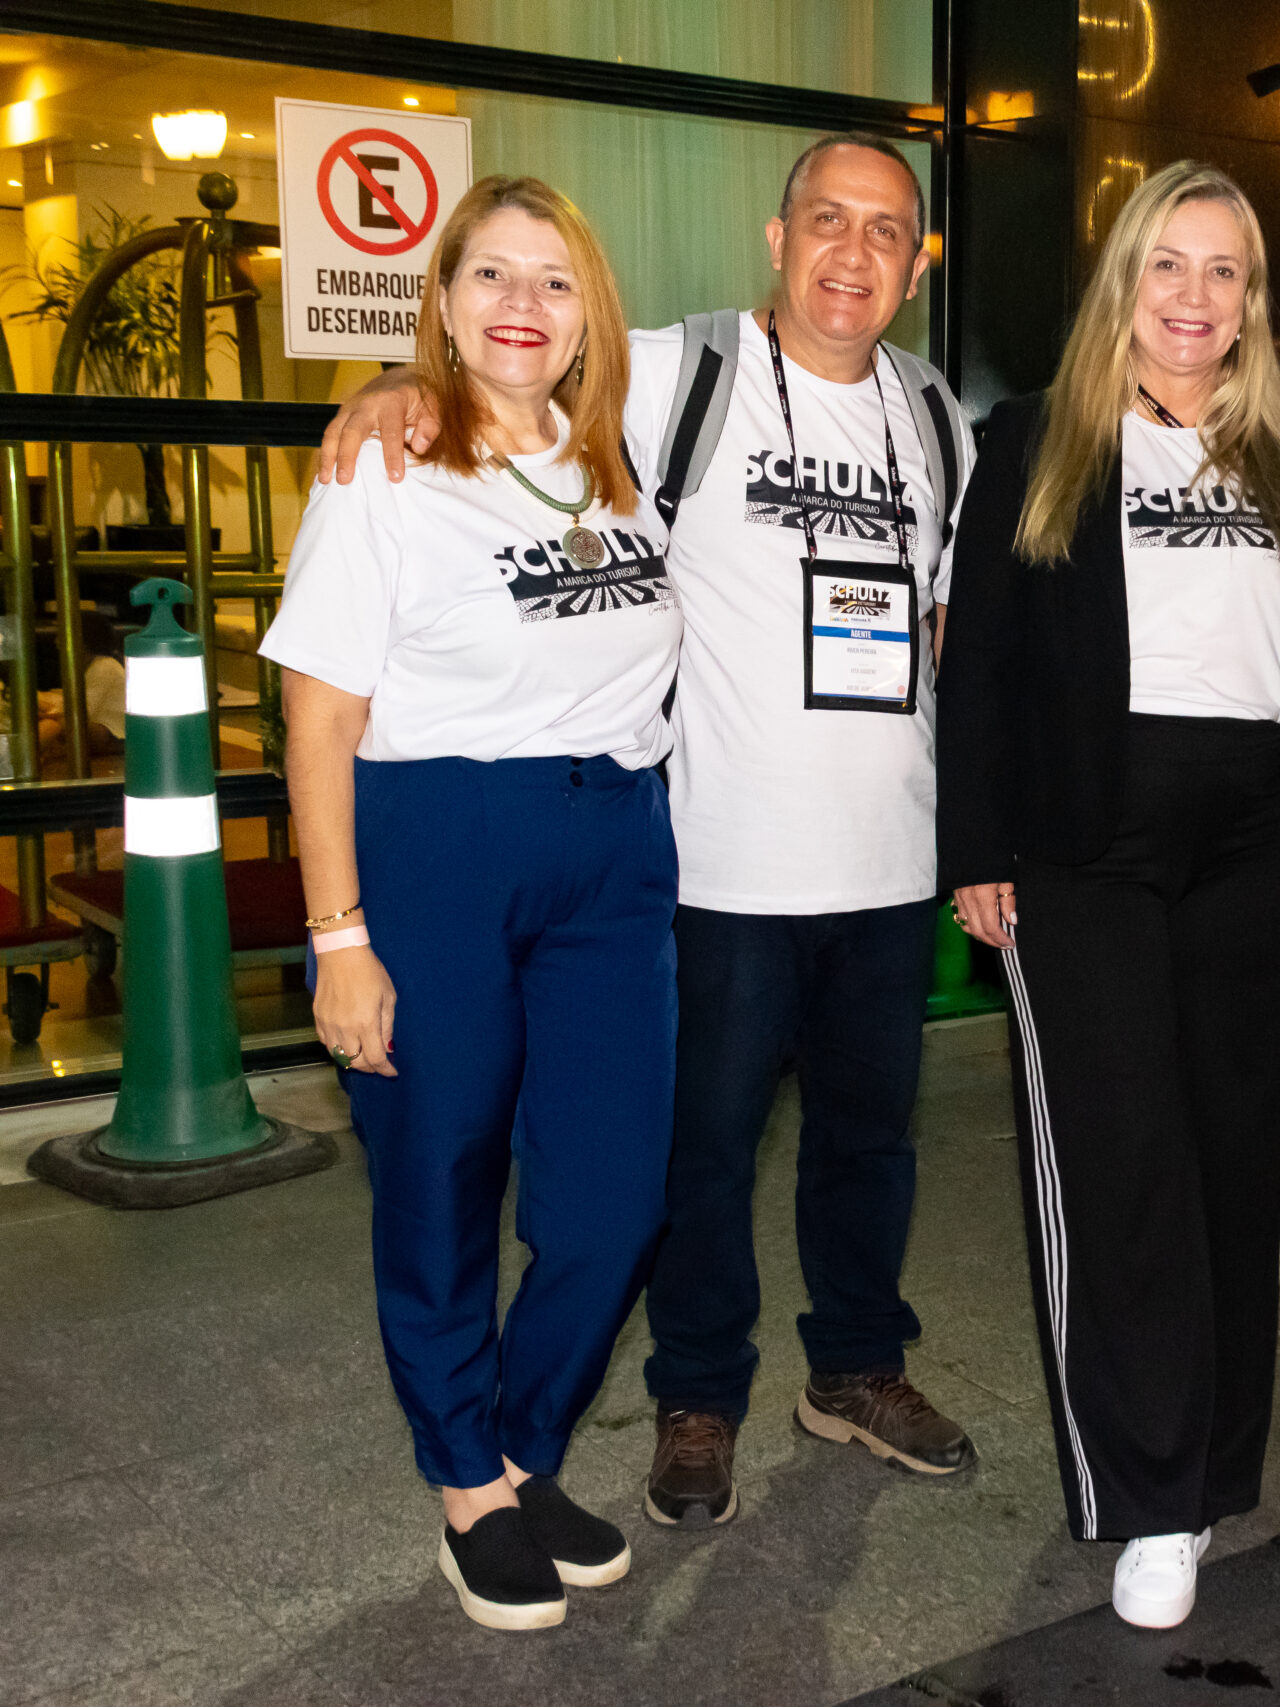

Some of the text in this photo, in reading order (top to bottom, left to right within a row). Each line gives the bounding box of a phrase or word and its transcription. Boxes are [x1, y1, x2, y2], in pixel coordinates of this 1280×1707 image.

[356, 153, 402, 231] E
[316, 268, 426, 300] EMBARQUE
[791, 493, 880, 515] A MARCA DO TURISMO
[1173, 515, 1180, 523] A
[1181, 515, 1212, 524] MARCA
[1213, 515, 1226, 524] DO
[556, 565, 641, 588] A MARCA DO TURISMO
[828, 584, 894, 603] SCHULTZ
